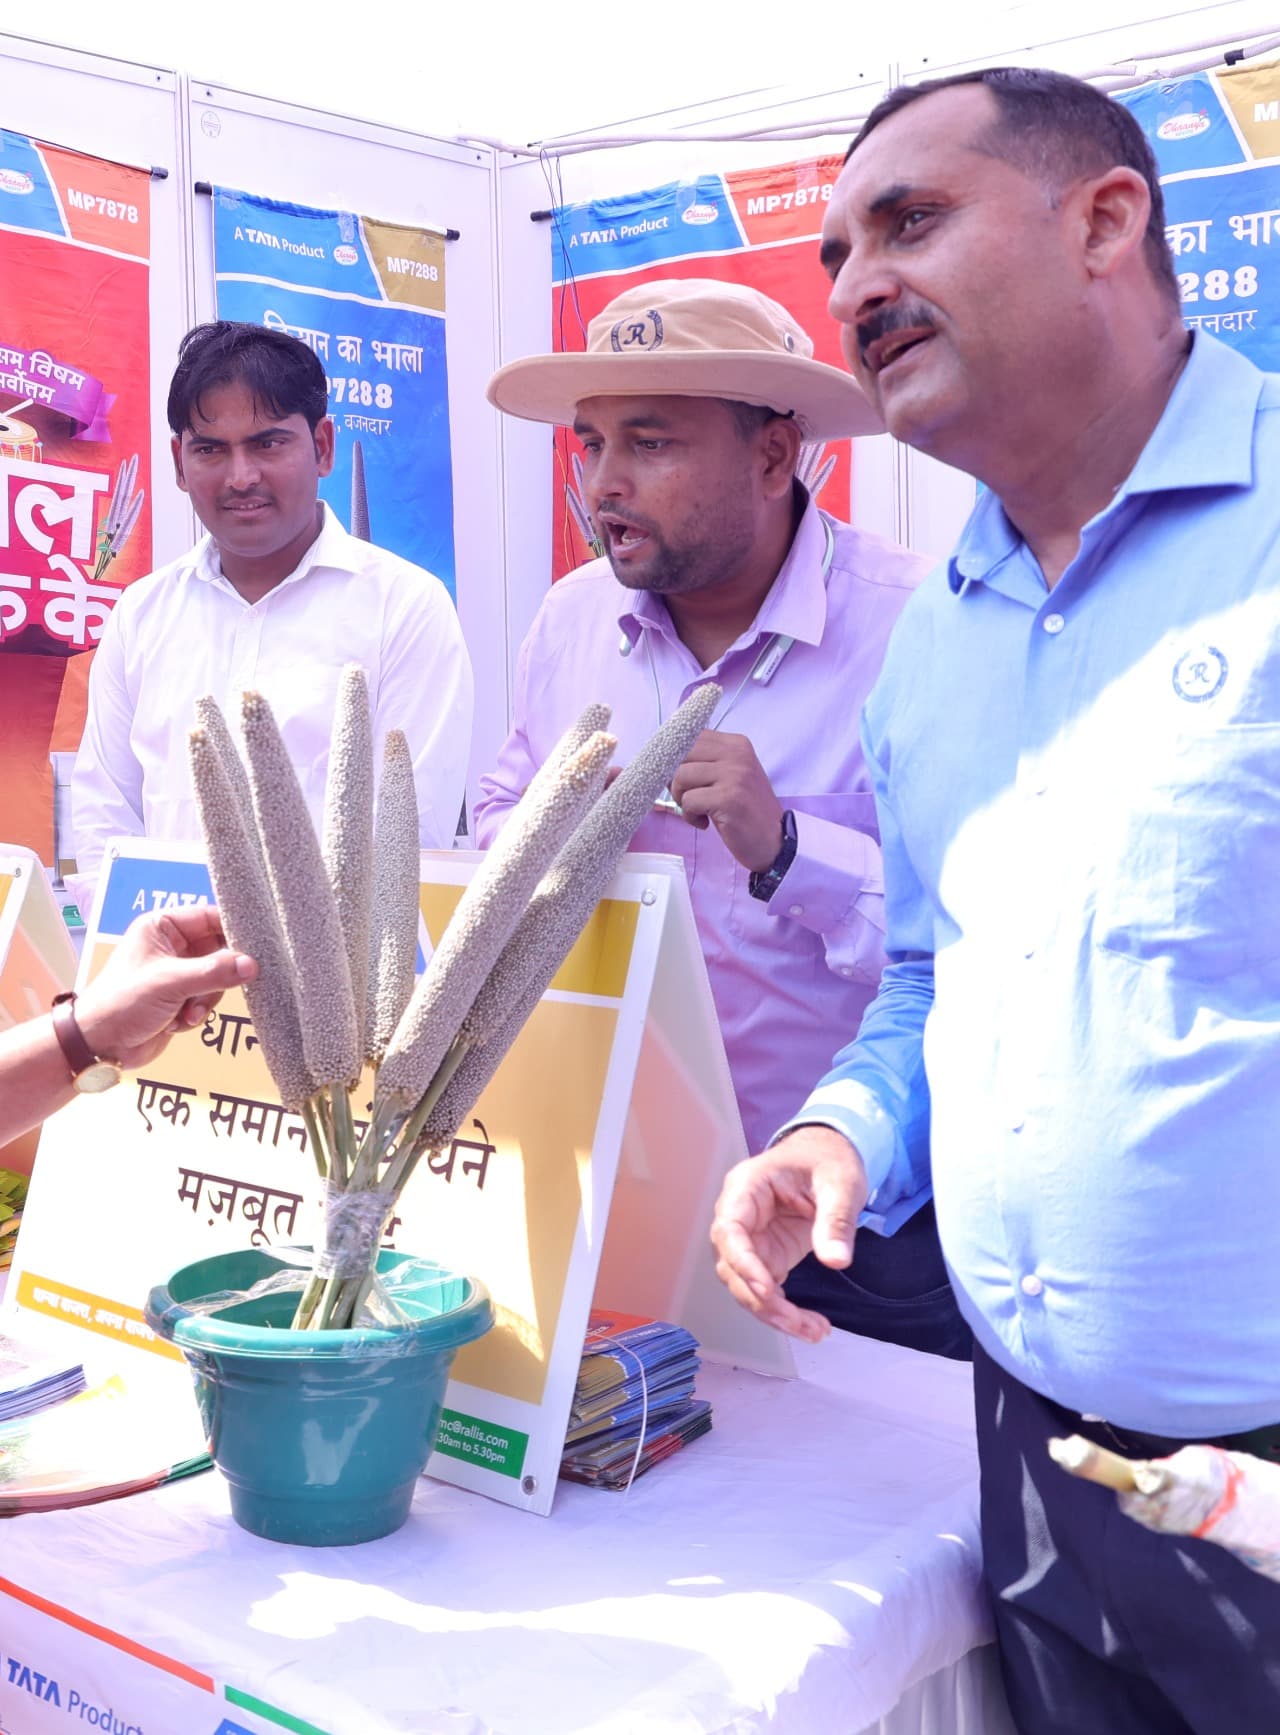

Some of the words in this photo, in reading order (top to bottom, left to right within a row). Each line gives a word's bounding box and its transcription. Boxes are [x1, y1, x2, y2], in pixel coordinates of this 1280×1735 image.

[68, 188, 140, 224] MP7878
[747, 183, 834, 216] MP7878
[234, 226, 245, 241] A
[246, 229, 281, 249] TATA
[282, 240, 326, 259] Product
[569, 234, 579, 248] A
[580, 230, 618, 245] TATA
[620, 217, 669, 239] Product
[387, 256, 439, 282] MP7288
[29, 351, 86, 391] विषम
[336, 335, 363, 364] का
[371, 340, 424, 374] भाला
[132, 889, 146, 911] A
[136, 1078, 197, 1132] एक
[209, 1092, 308, 1153] समान
[462, 1441, 472, 1452] to
[472, 1445, 506, 1464] 5.30pm
[7, 1657, 62, 1707] TATA
